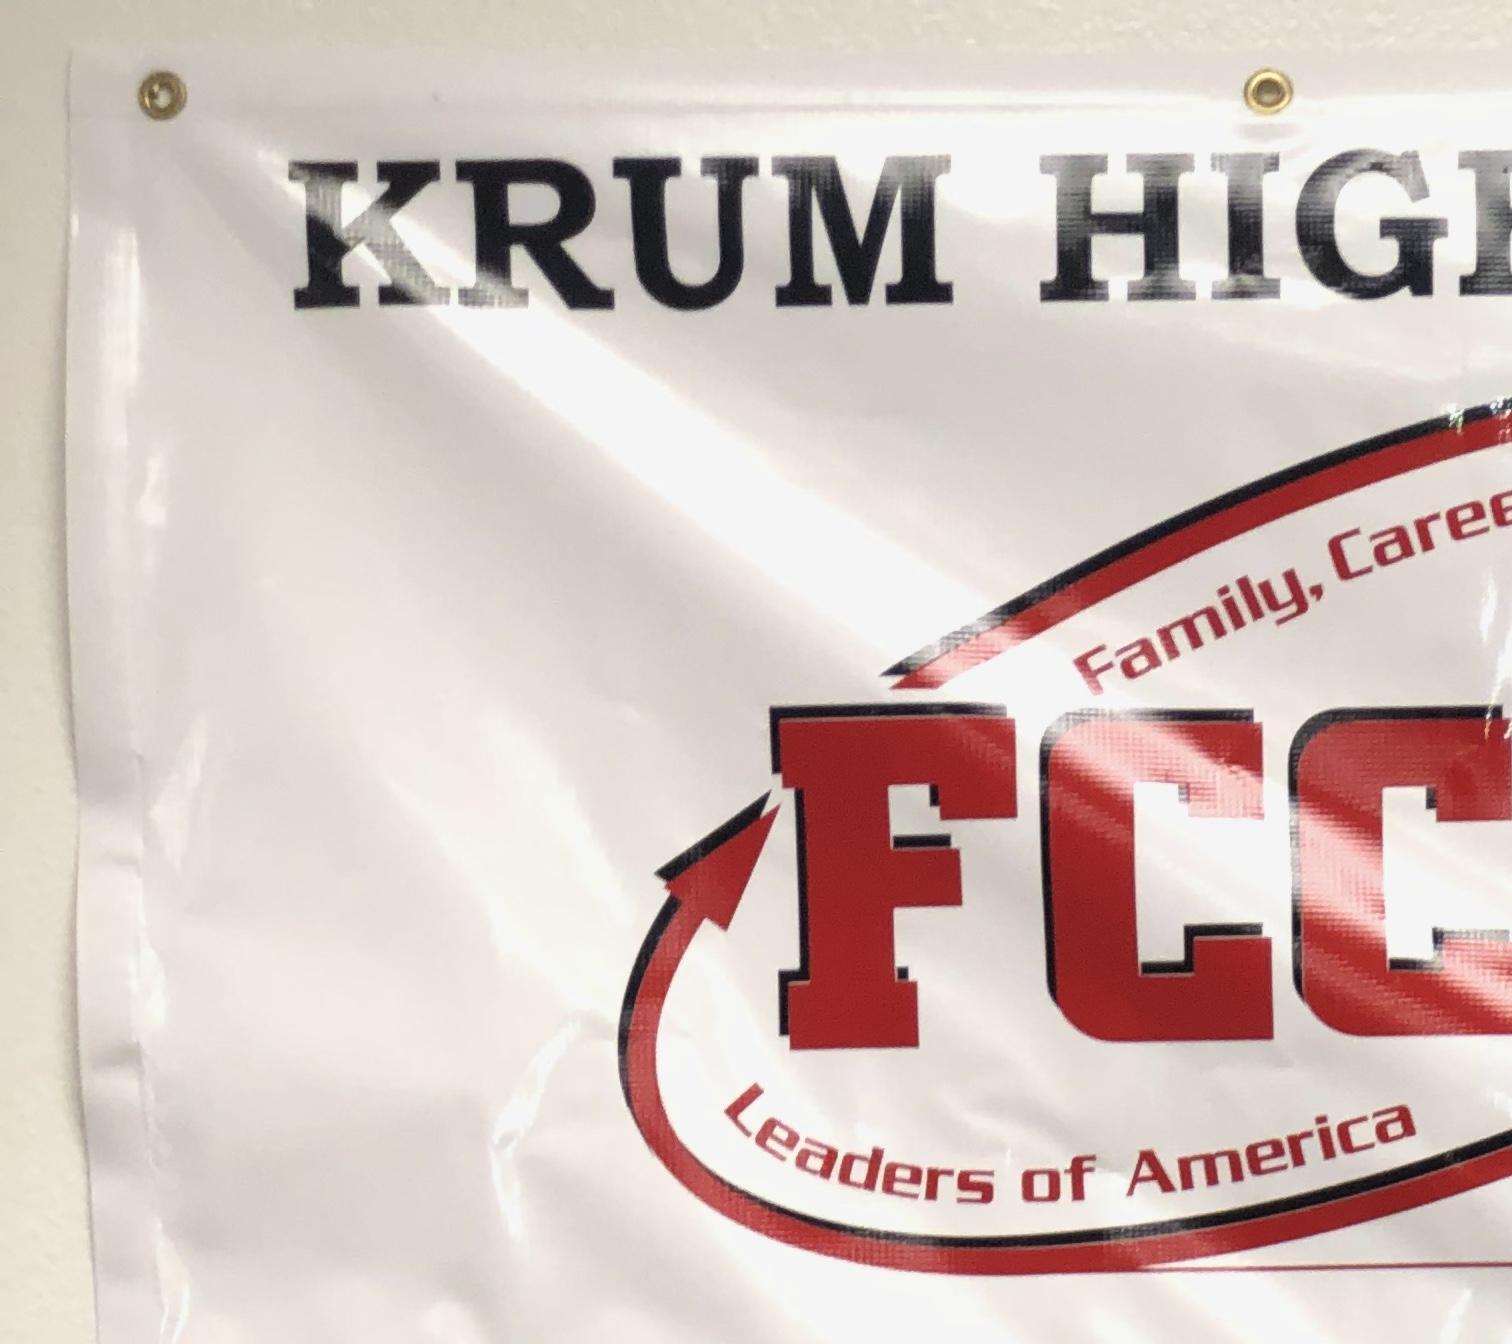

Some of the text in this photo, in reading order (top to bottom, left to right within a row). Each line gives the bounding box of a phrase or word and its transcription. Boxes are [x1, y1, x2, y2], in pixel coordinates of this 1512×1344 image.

[288, 152, 954, 312] KRUM
[1072, 564, 1325, 698] Family,
[723, 1082, 1417, 1205] Leaders of America
